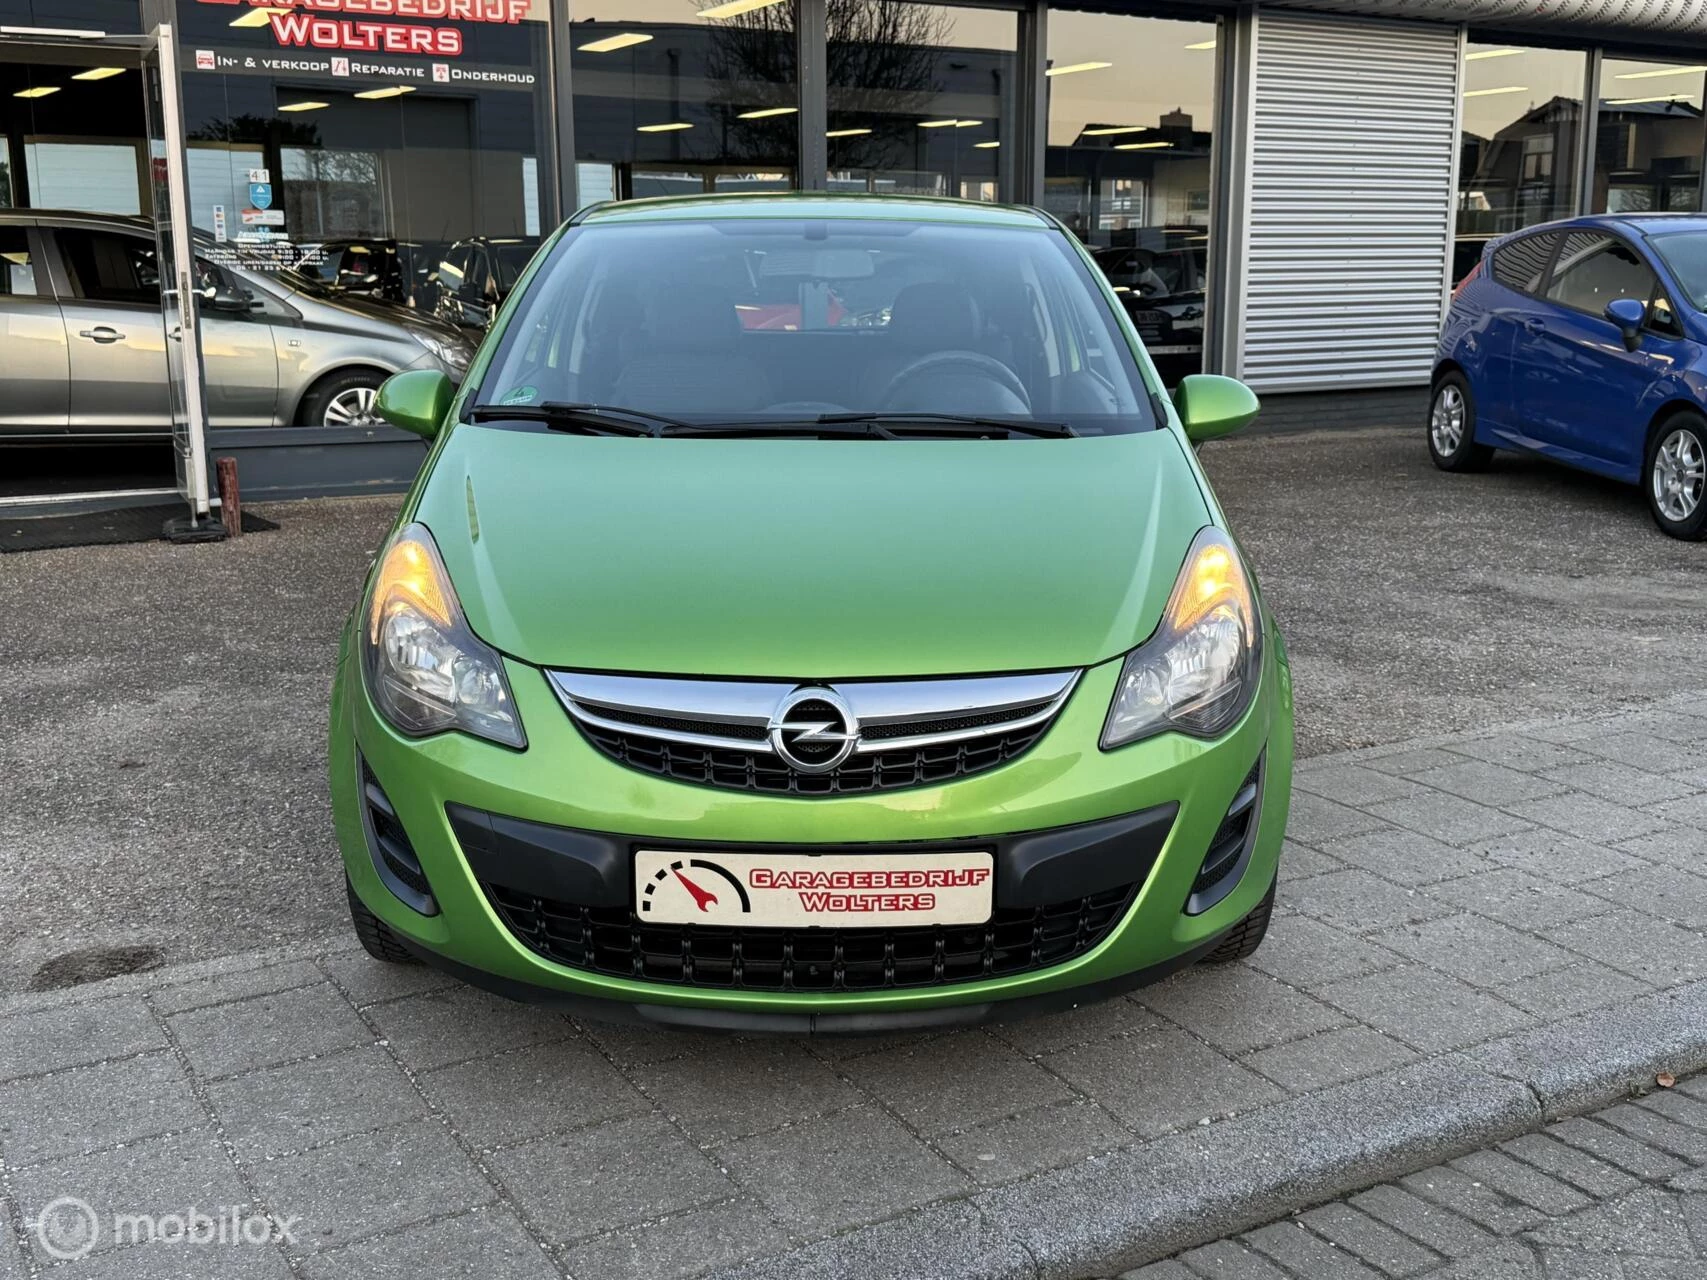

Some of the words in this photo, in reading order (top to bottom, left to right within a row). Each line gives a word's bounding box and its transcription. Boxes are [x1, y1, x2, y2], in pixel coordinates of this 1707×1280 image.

[267, 12, 462, 56] WOLTERS
[244, 57, 256, 68] &
[262, 59, 330, 71] VERKOOP
[351, 63, 425, 77] REPARATIE
[451, 69, 535, 84] ONDERHOUD
[251, 170, 268, 182] 41
[749, 868, 990, 889] GARAGEBEDRIJF
[798, 892, 936, 912] WOLTERS
